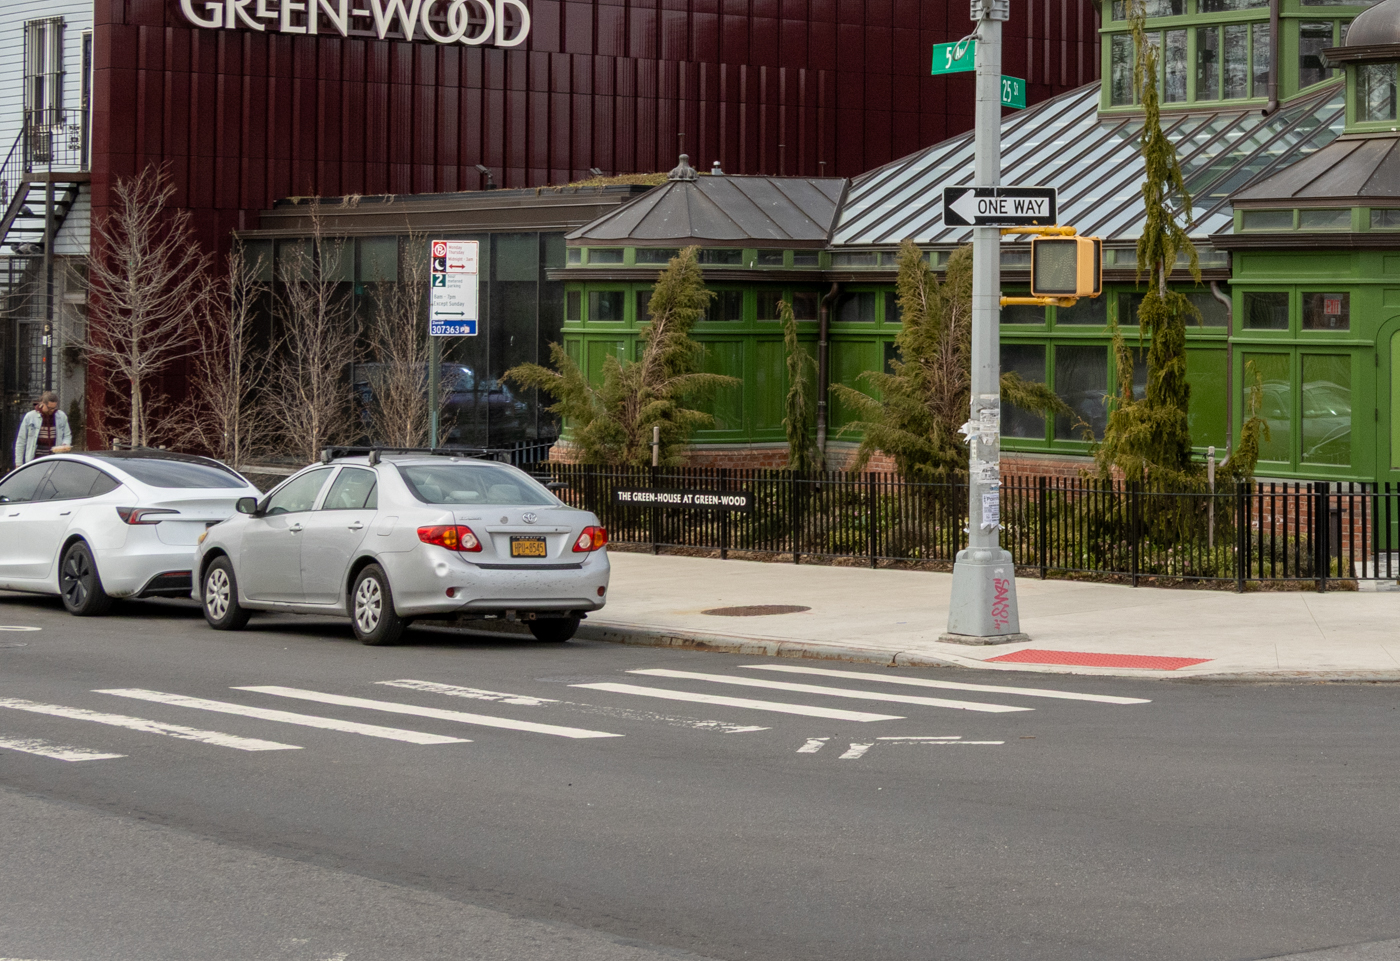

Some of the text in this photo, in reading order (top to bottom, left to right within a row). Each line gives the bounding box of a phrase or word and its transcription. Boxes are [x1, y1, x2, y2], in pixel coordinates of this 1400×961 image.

[945, 46, 953, 69] 5
[1002, 79, 1019, 103] 25 St
[977, 199, 1044, 214] ONE WAY
[435, 274, 444, 287] 2
[432, 326, 460, 334] 307363
[618, 491, 746, 506] THE GREEN-HOUSE AT GREEN-WOOD
